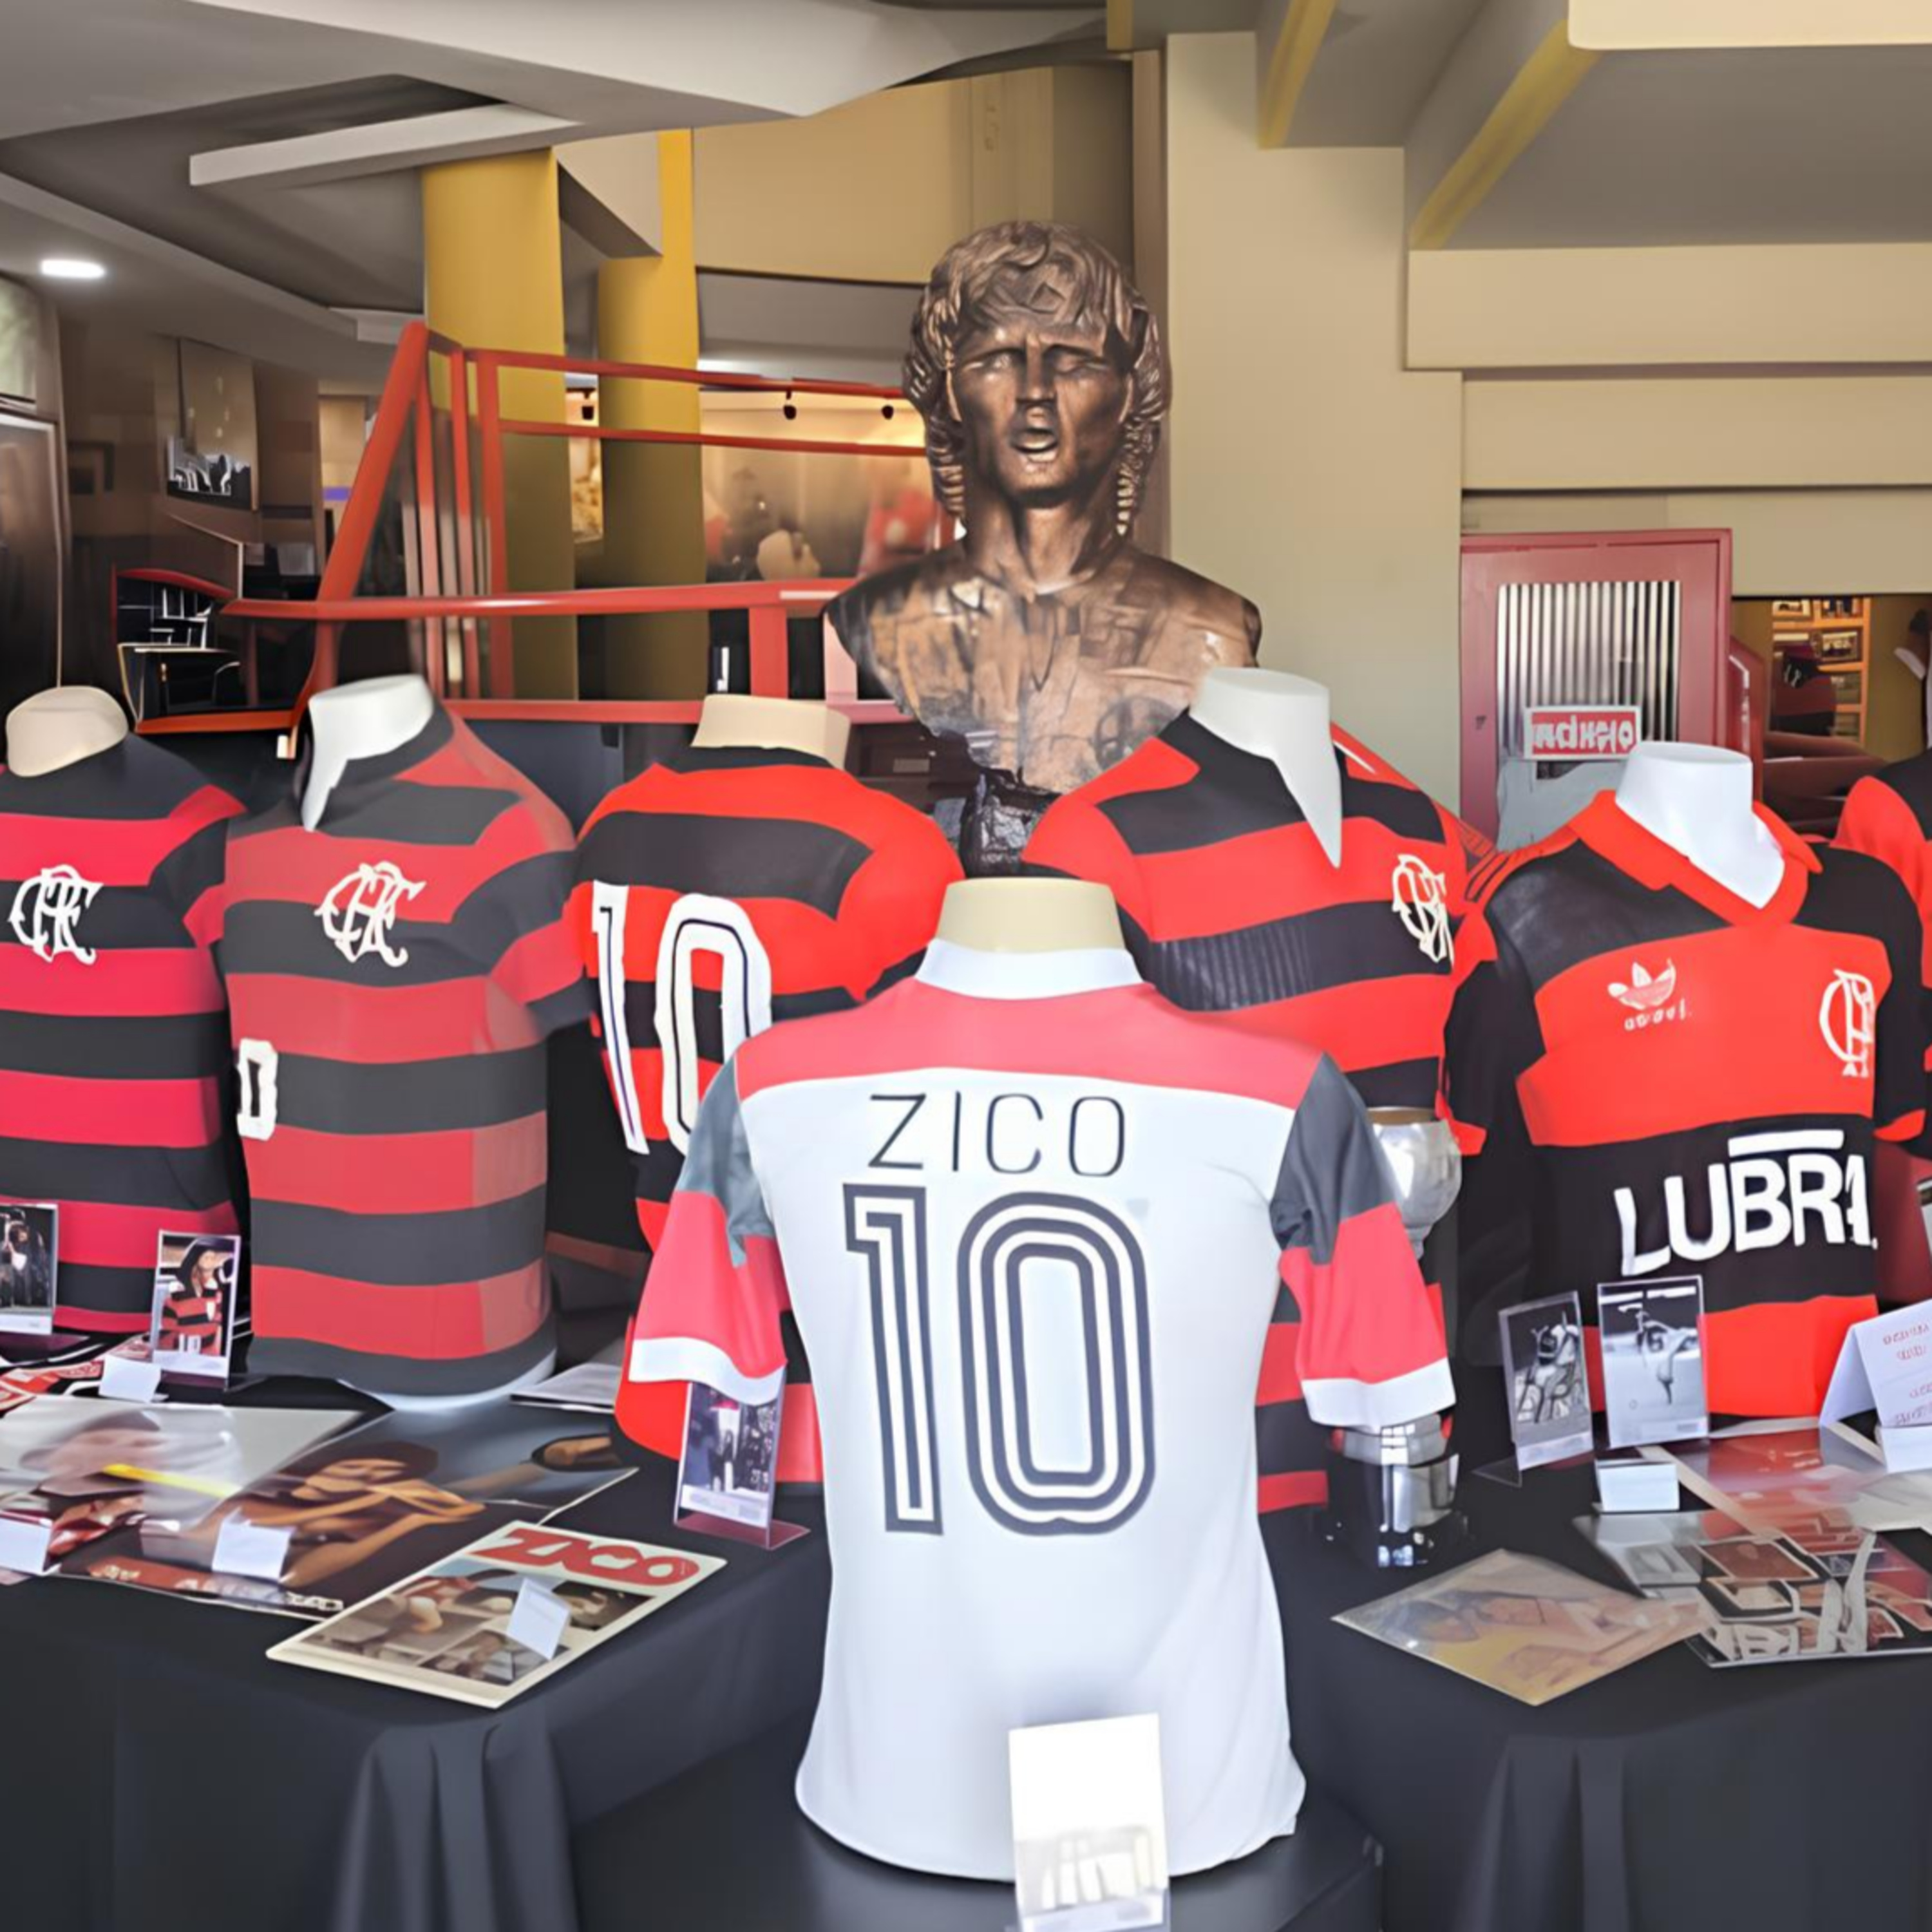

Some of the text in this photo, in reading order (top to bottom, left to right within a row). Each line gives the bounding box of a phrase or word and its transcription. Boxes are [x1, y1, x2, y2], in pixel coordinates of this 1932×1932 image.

[592, 880, 773, 1157] 10
[867, 1090, 1125, 1177] ZICO
[842, 1182, 1157, 1537] 10
[465, 1528, 701, 1586] ZICO
